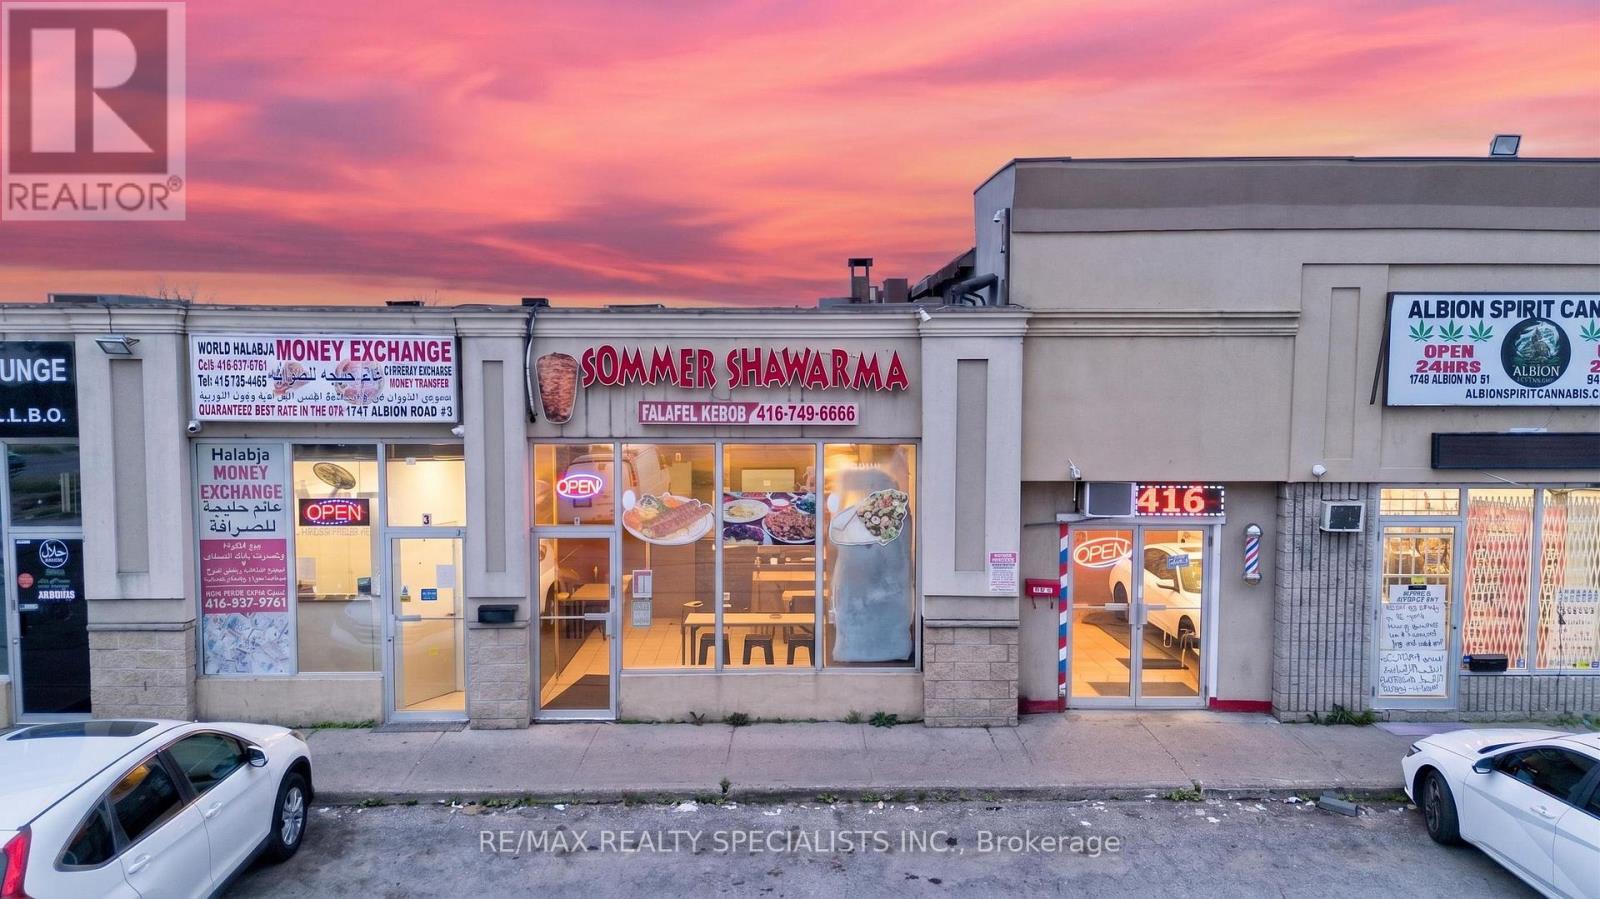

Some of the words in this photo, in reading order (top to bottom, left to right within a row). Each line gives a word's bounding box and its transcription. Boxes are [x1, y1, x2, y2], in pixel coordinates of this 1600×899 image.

[1408, 300, 1484, 318] ALBION
[1490, 300, 1555, 318] SPIRIT
[198, 342, 230, 355] WORLD
[233, 342, 275, 356] HALABJA
[276, 340, 344, 361] MONEY
[350, 340, 452, 362] EXCHANGE
[1424, 345, 1474, 358] OPEN
[0, 358, 66, 382] UNGE
[581, 344, 717, 390] SOMMER
[726, 347, 910, 392] SHAWARMA
[1416, 360, 1481, 373] 24HRS
[1513, 366, 1560, 377] ALBION
[198, 375, 213, 387] Tel:
[390, 378, 413, 388] MONEY
[1431, 374, 1463, 384] ALBION
[1480, 374, 1490, 384] 51
[1465, 388, 1599, 399] ALBIONSPIRITCANNABIS.C
[0, 408, 66, 423] .L.B.O.
[255, 405, 275, 416] BEST
[277, 405, 298, 416] RATE
[300, 405, 308, 416] IN
[310, 405, 326, 416] THE
[371, 405, 407, 417] ALBION
[410, 405, 437, 417] ROAD
[441, 405, 453, 417] #3
[642, 404, 698, 422] FALAFEL
[701, 405, 746, 422] KEBOB
[757, 405, 855, 422] 416-749-6666
[212, 448, 270, 464] Halabja
[213, 465, 268, 480] MONEY
[201, 484, 283, 499] EXCHANGE
[557, 479, 600, 494] OPEN
[1137, 485, 1205, 513] 416
[307, 504, 361, 520] OPEN
[423, 515, 430, 525] 3
[1075, 542, 1128, 563] OPEN
[205, 597, 286, 609] 416-937-9761
